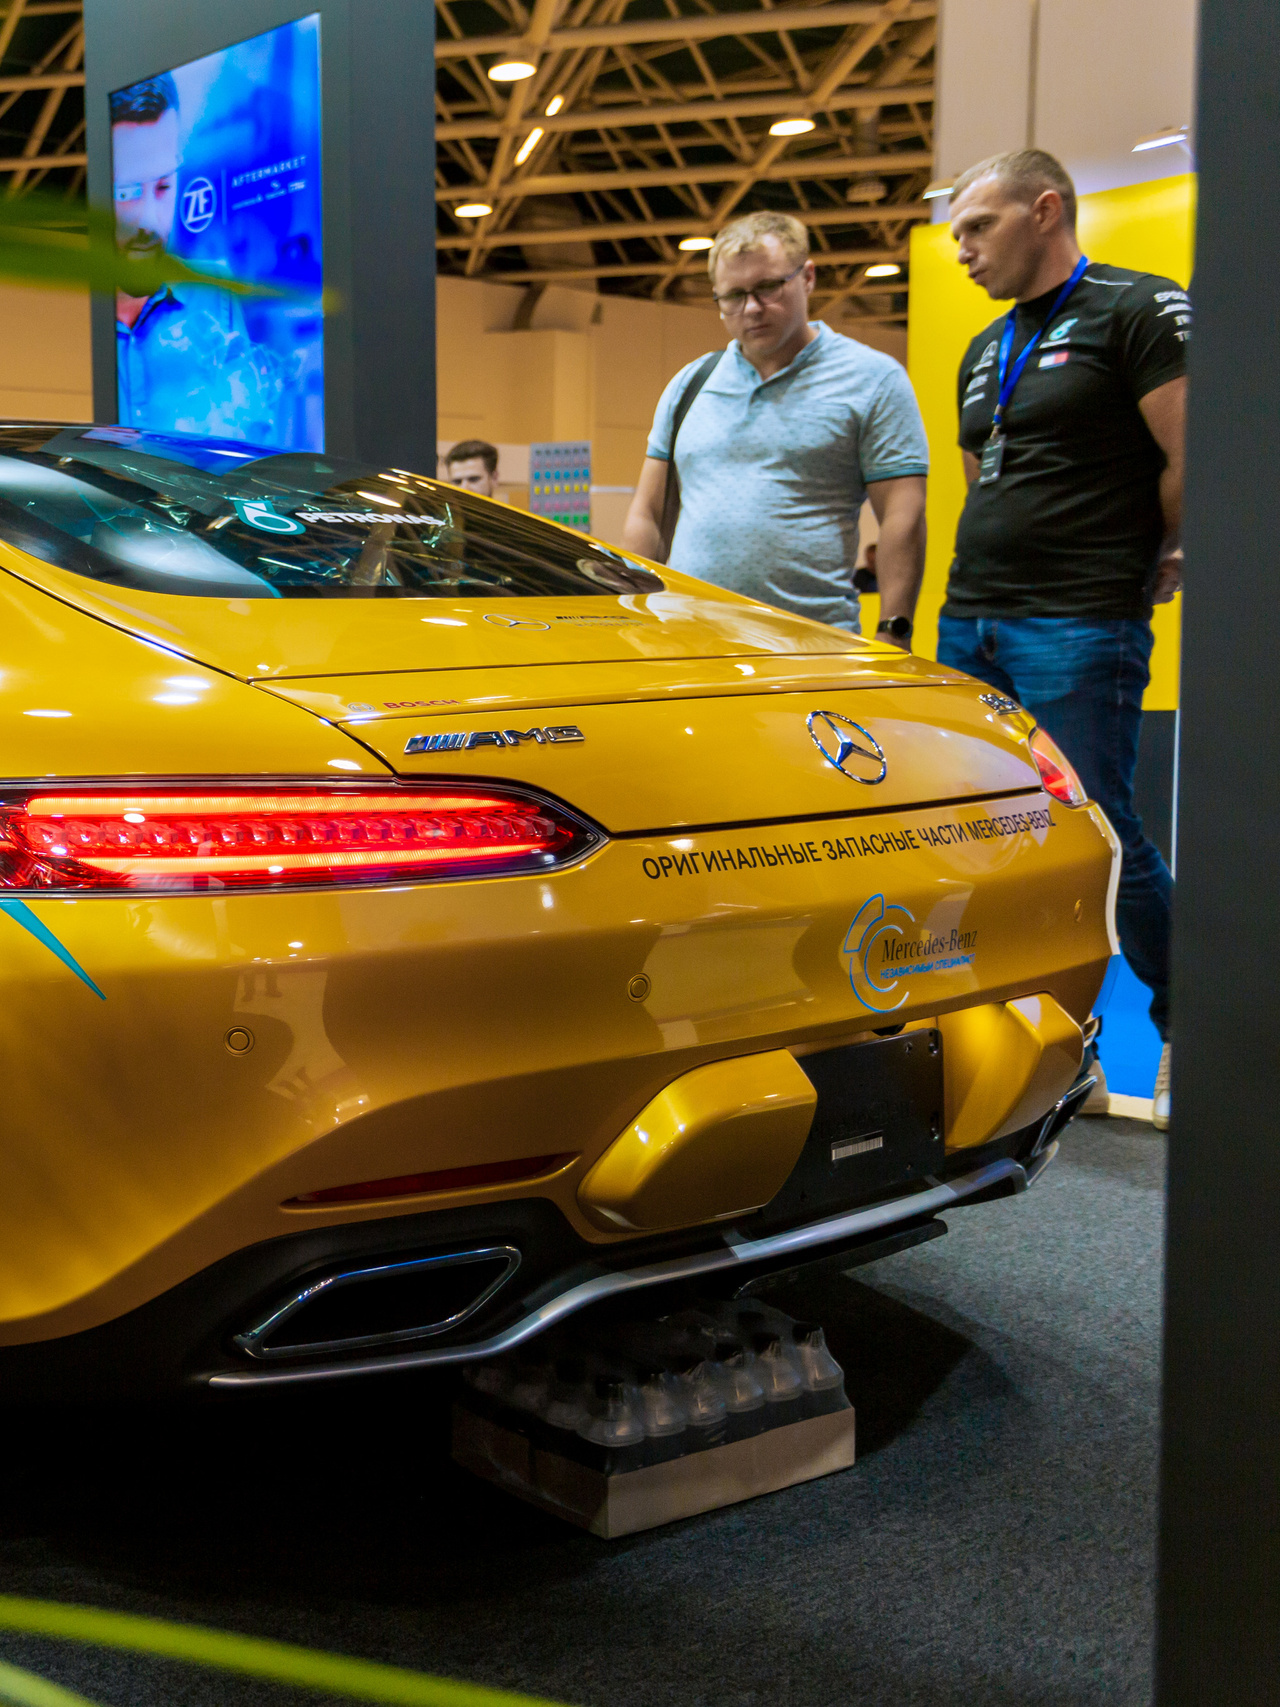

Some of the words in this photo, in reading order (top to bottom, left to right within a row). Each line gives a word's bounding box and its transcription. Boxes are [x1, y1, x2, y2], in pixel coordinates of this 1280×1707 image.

[231, 155, 306, 188] AFTERMARKET
[183, 183, 214, 225] ZF
[295, 511, 446, 526] PETRONAS
[383, 699, 461, 709] BOSCH
[465, 725, 585, 749] AMG
[642, 842, 822, 880] ОРИГИНАЛЬНЫЕ
[822, 830, 920, 860] ЗАПАСНЫЕ
[917, 822, 969, 847] ЧАСТИ
[965, 809, 1057, 841] MERCEDES-BENZ
[881, 929, 977, 962] Mercedes-Benz
